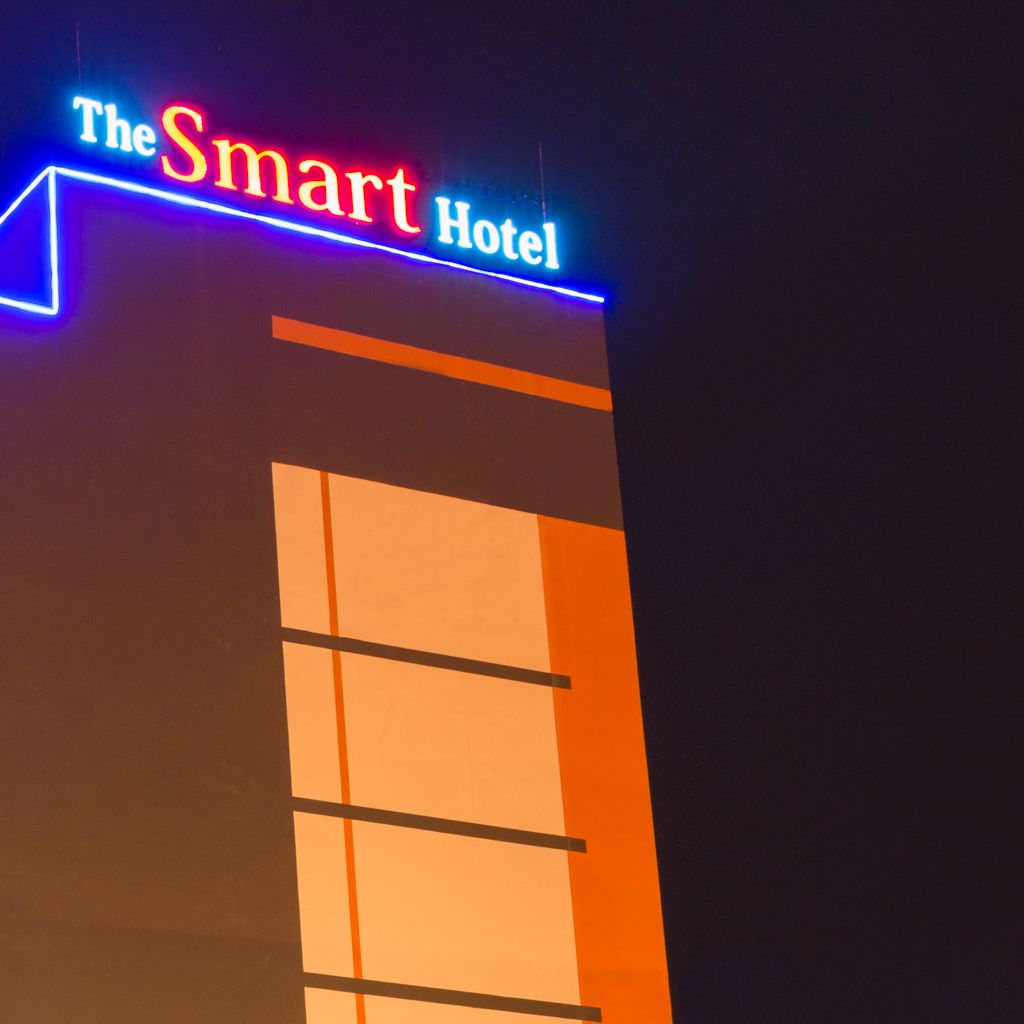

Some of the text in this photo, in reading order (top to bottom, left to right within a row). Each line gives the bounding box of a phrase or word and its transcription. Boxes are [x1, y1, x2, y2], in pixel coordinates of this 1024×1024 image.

[72, 96, 561, 269] The Smart Hotel
